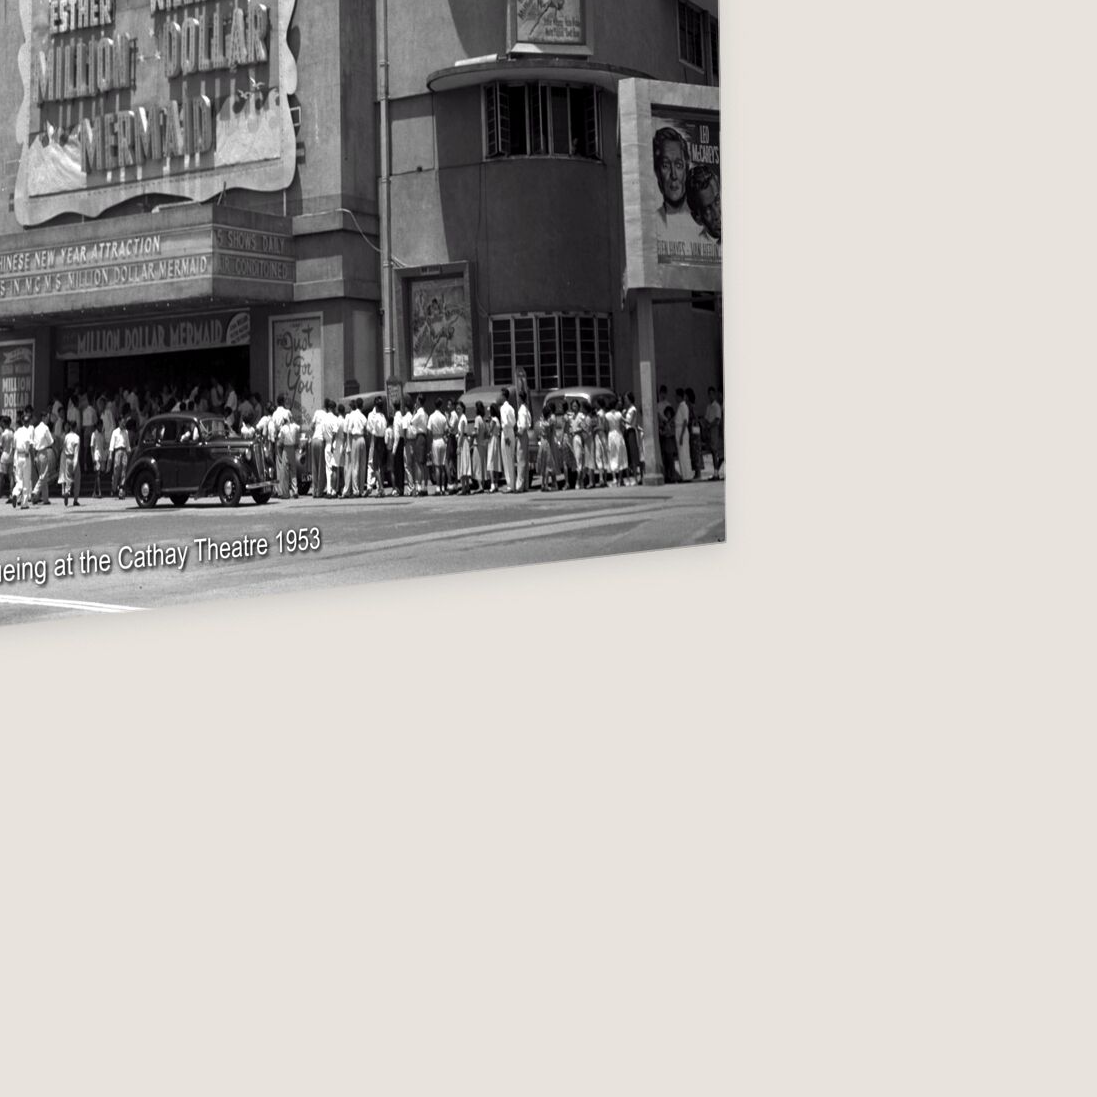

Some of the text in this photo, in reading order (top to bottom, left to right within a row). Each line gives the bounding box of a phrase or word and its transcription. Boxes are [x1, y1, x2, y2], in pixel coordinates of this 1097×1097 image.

[31, 4, 270, 102] MILLION DOLLAR
[81, 94, 215, 173] MERMAID
[699, 125, 710, 144] LEO
[35, 250, 56, 268] NEW
[61, 245, 87, 264] YEAR
[91, 235, 161, 261] ATTRACTION
[227, 230, 257, 251] SHOWS
[10, 278, 21, 296] IN
[68, 267, 109, 288] MILLION
[114, 262, 155, 284] DOLLAR
[158, 256, 208, 278] MERMAID
[77, 328, 121, 353] MILLION
[124, 324, 167, 349] DOLLAR
[169, 319, 223, 347] MERMAID
[1, 376, 31, 393] MILLION
[3, 392, 29, 408] DOLLAR
[287, 368, 314, 410] You
